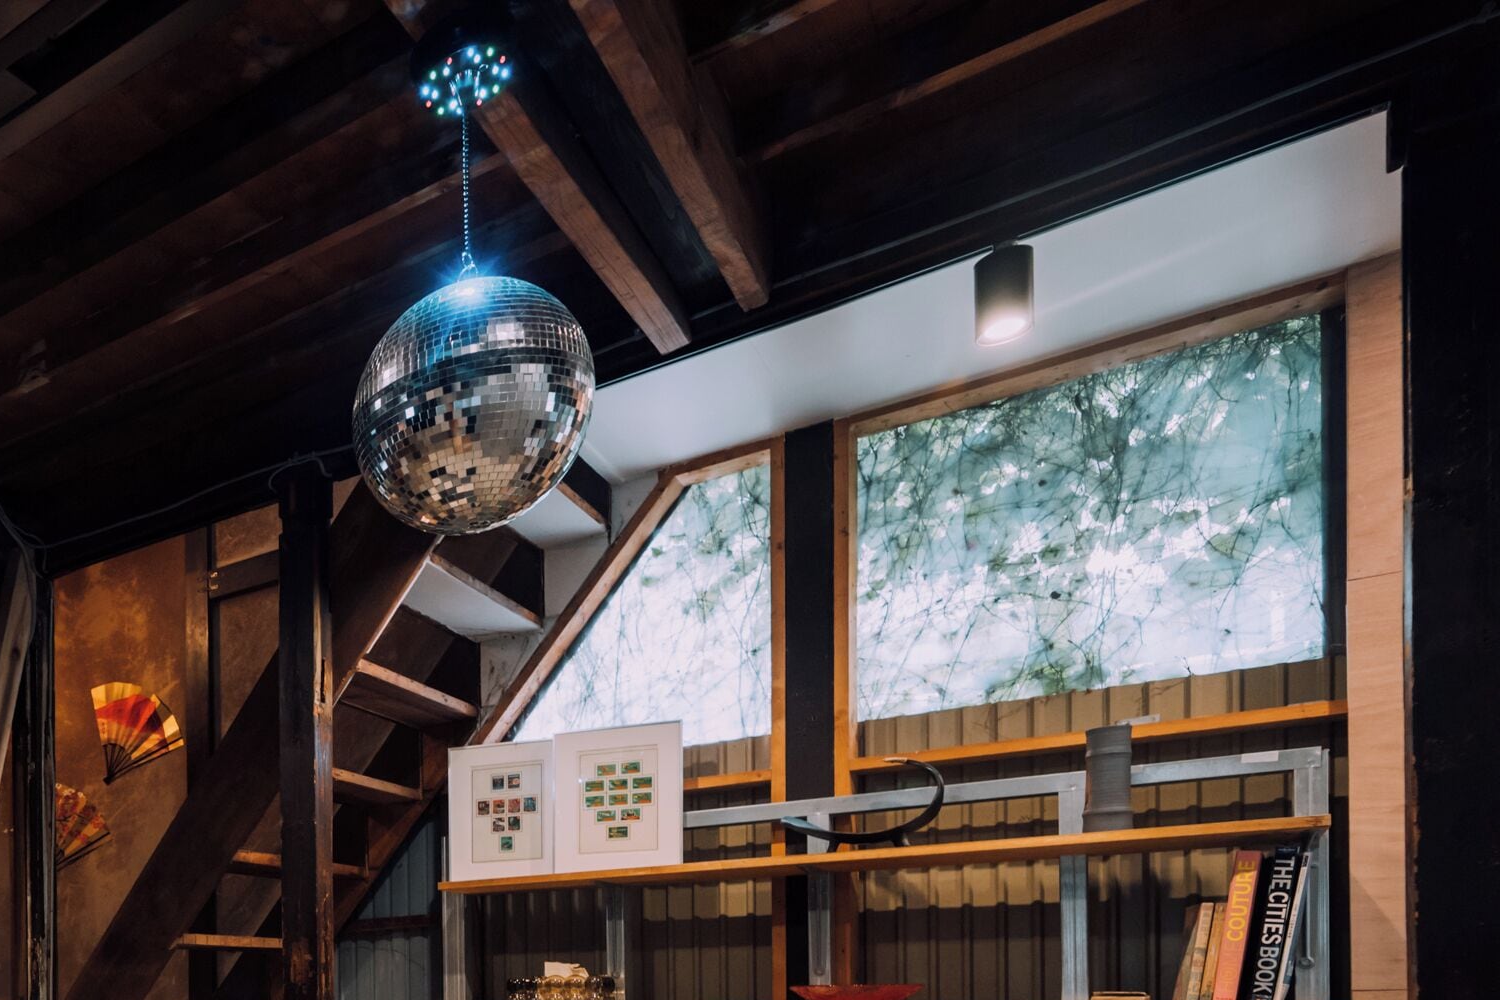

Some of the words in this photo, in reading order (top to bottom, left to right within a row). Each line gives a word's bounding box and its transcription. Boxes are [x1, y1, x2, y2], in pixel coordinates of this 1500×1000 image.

[1271, 856, 1296, 890] THE
[1227, 860, 1255, 942] COUTURE
[1261, 891, 1289, 945] CITIES
[1252, 946, 1279, 993] BOOK
